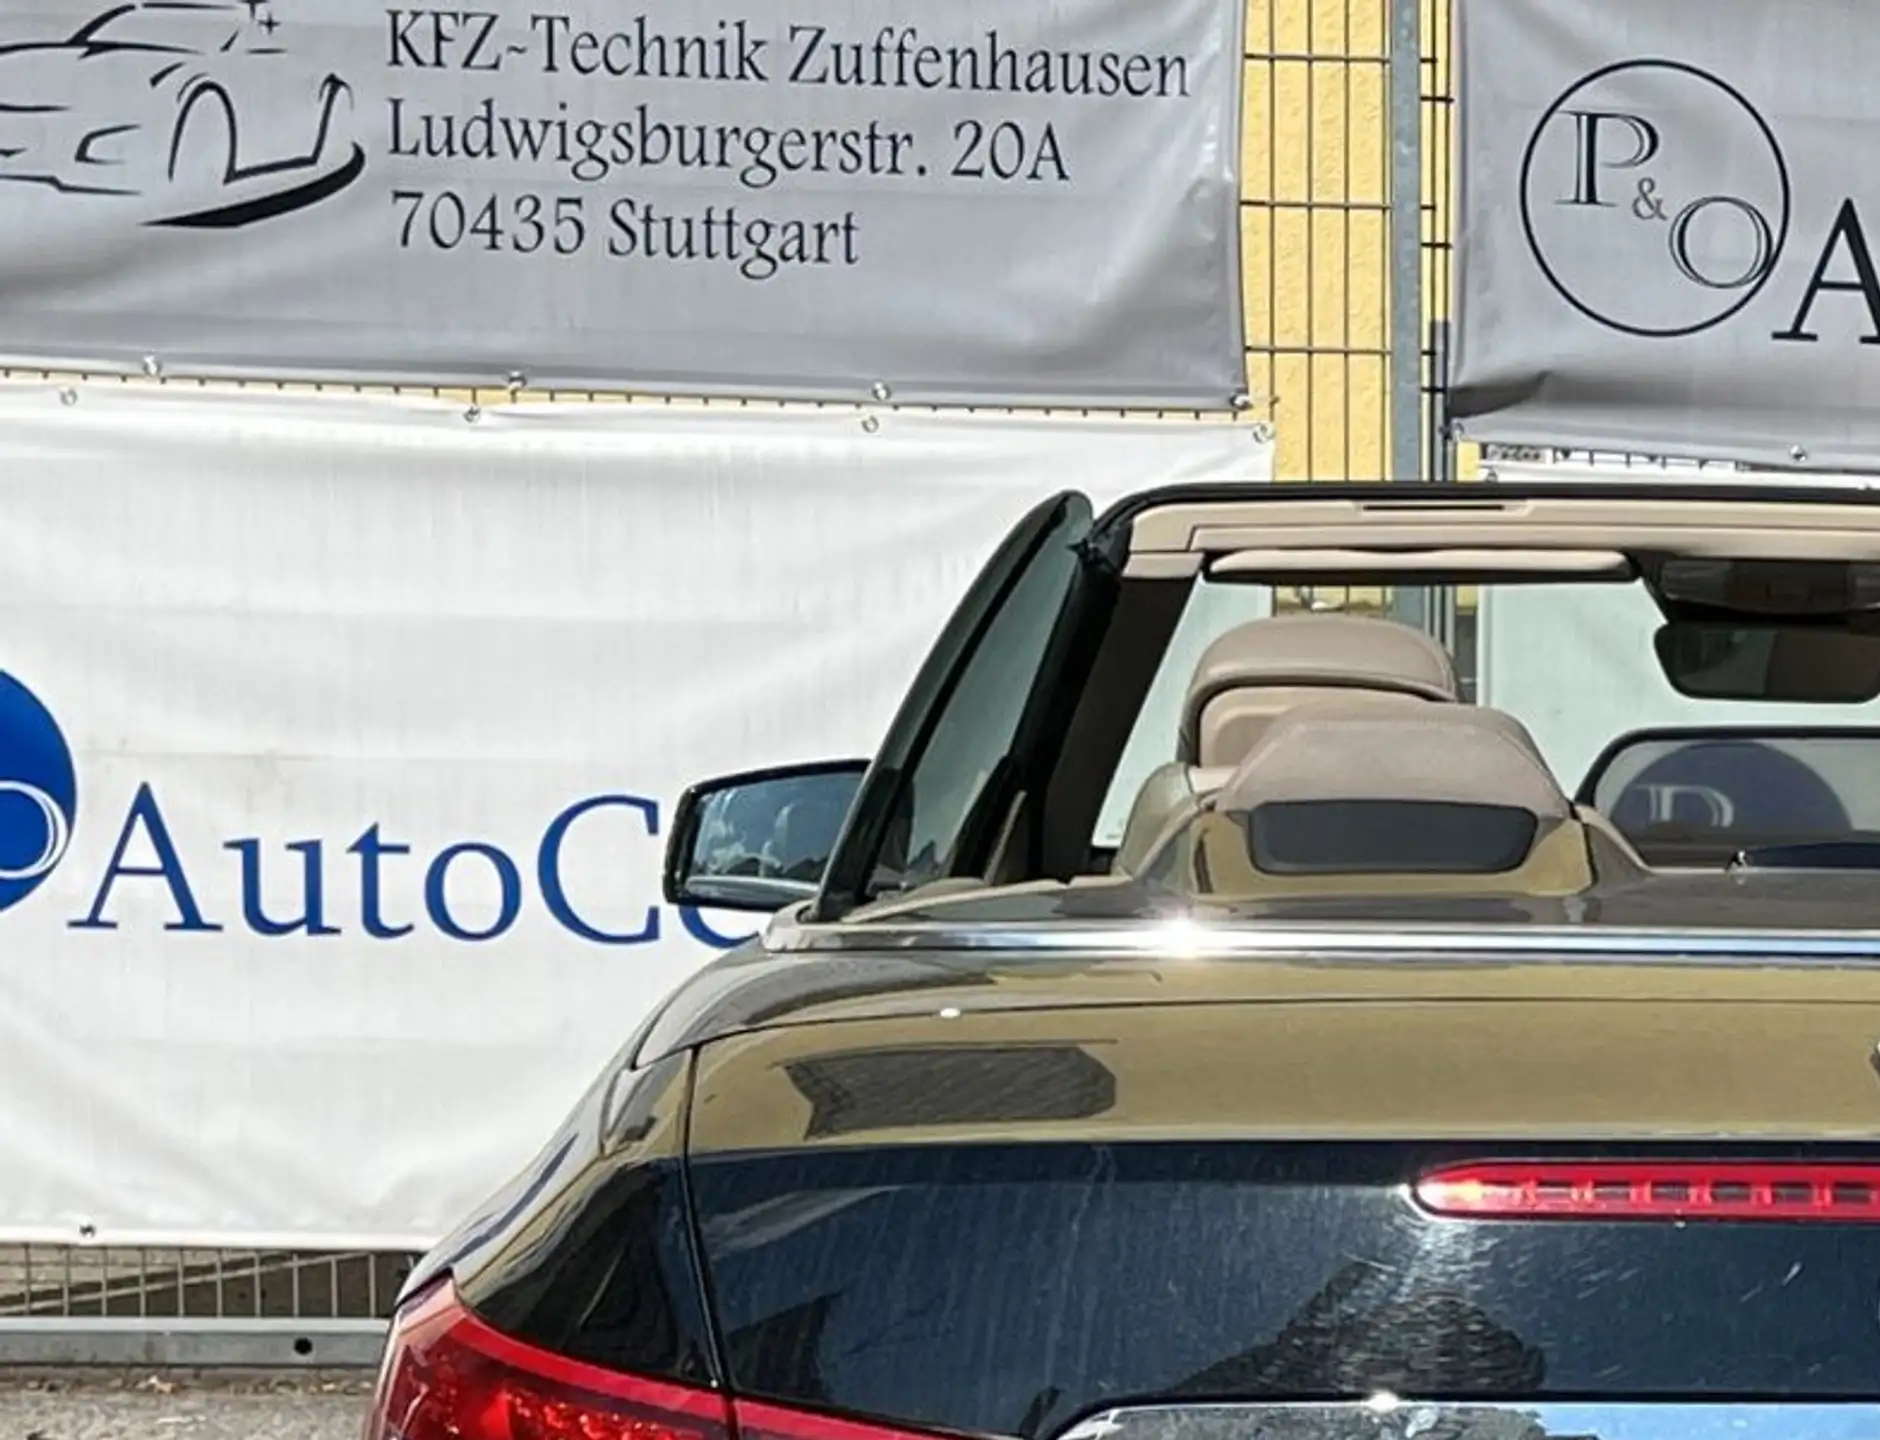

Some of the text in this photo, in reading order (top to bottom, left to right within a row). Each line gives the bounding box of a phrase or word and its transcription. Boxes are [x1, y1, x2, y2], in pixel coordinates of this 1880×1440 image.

[788, 25, 1188, 98] Zuffenhausen
[388, 97, 1070, 189] Ludwigsburgerstr. 20A
[391, 189, 861, 279] 70435 Stuttgart
